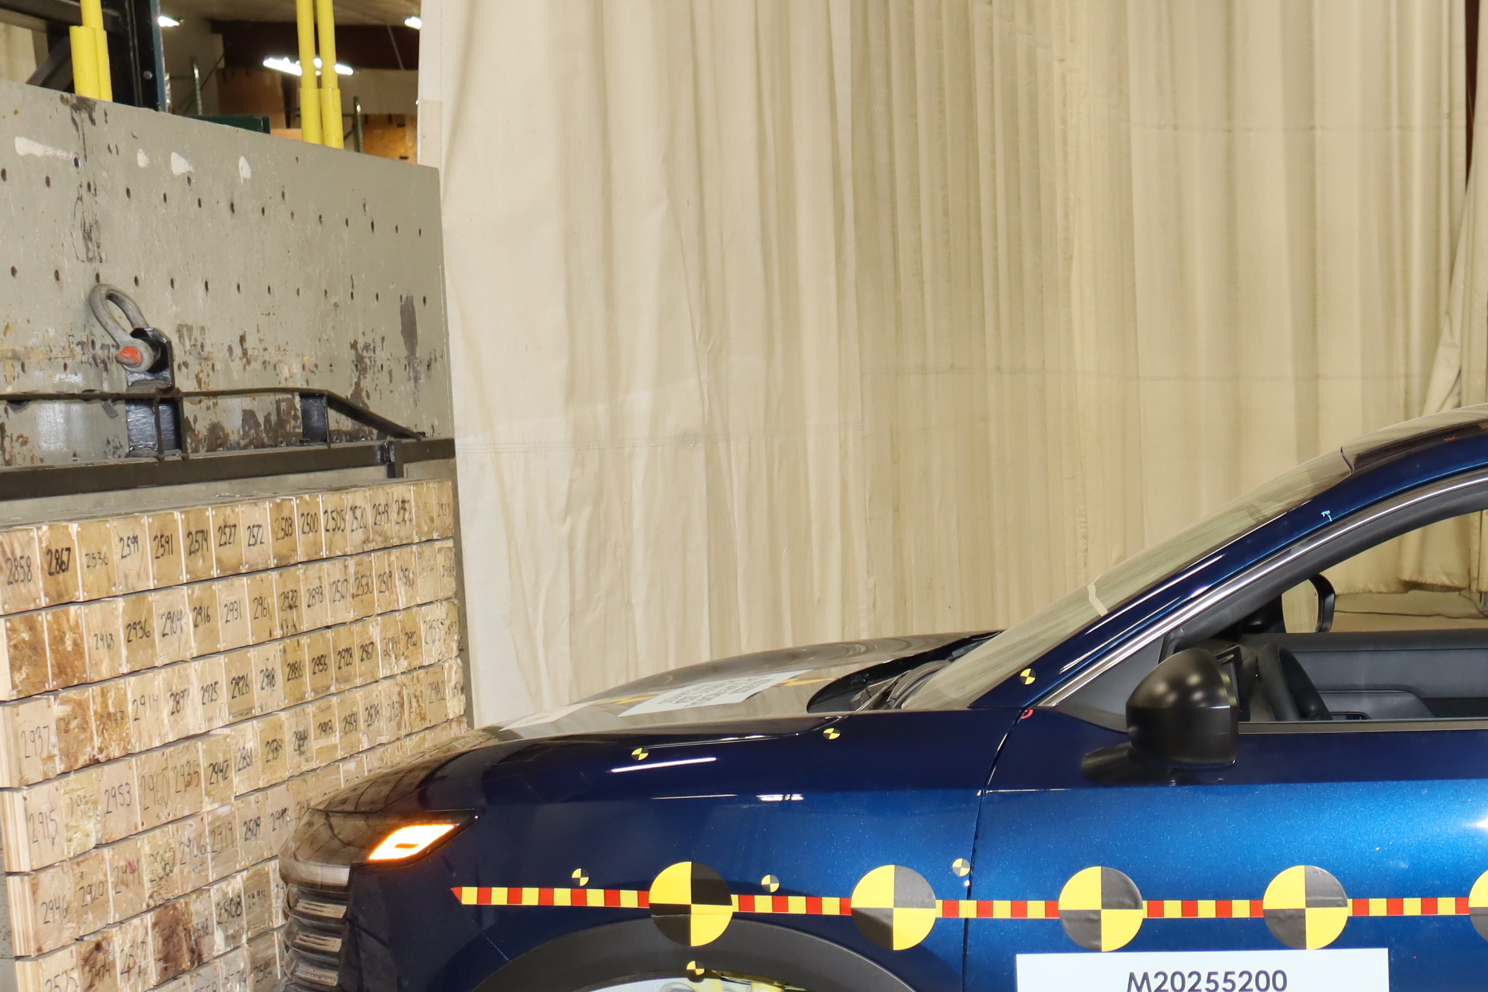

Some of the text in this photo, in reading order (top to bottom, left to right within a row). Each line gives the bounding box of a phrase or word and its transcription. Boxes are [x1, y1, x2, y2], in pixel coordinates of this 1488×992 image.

[217, 524, 237, 547] 2527
[247, 524, 265, 547] 2572
[275, 517, 293, 541] 2503
[301, 512, 318, 535] 2500
[153, 534, 173, 560] 2591
[6, 556, 33, 585] 2858
[47, 547, 71, 576] 2867
[223, 601, 242, 624] 2931
[126, 620, 151, 643] 2936
[20, 725, 50, 759] 2937
[104, 782, 132, 815] 2953
